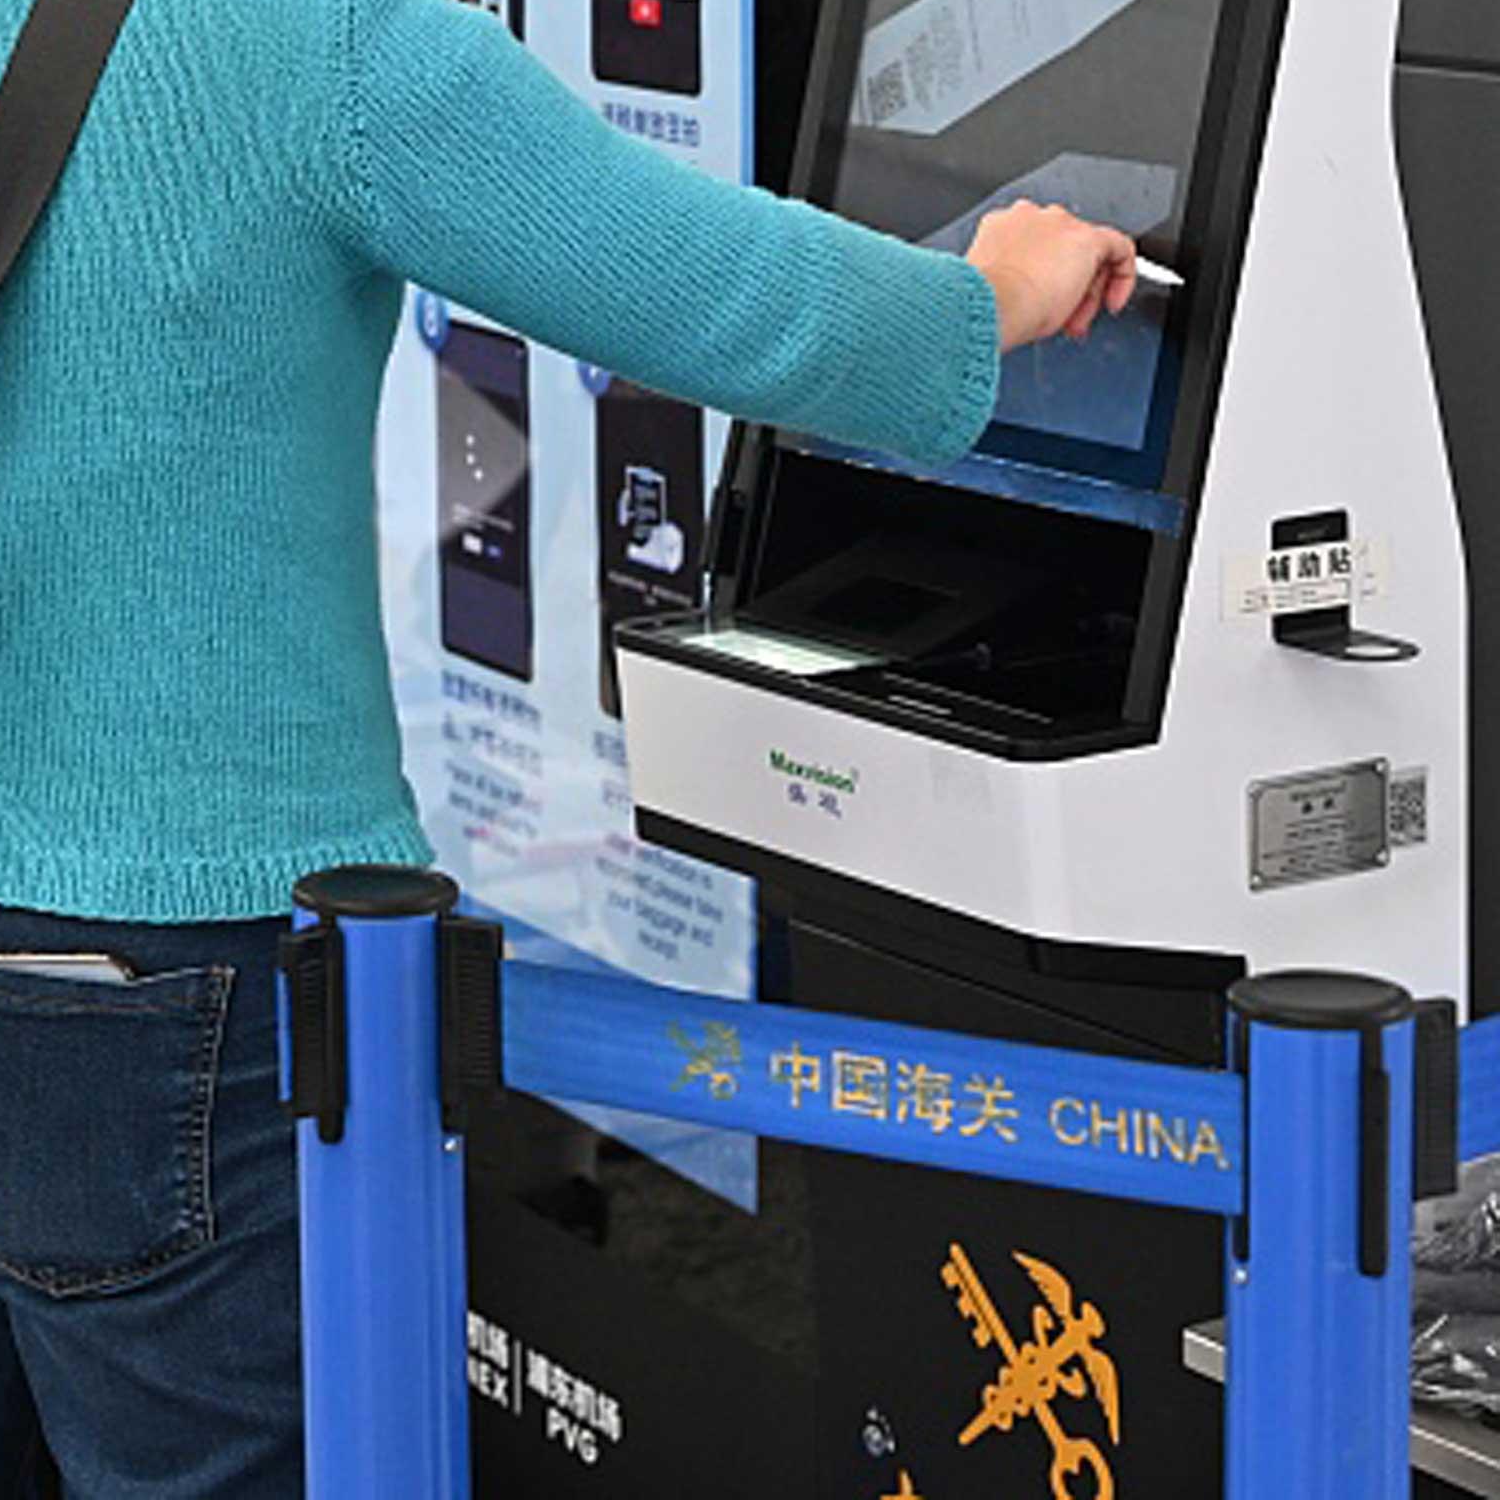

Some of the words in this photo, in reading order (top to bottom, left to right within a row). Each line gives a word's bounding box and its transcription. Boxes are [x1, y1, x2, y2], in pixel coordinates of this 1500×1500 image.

[769, 1041, 1019, 1143] 中国海关
[1048, 1096, 1232, 1171] CHINA
[546, 1405, 599, 1465] PVG
